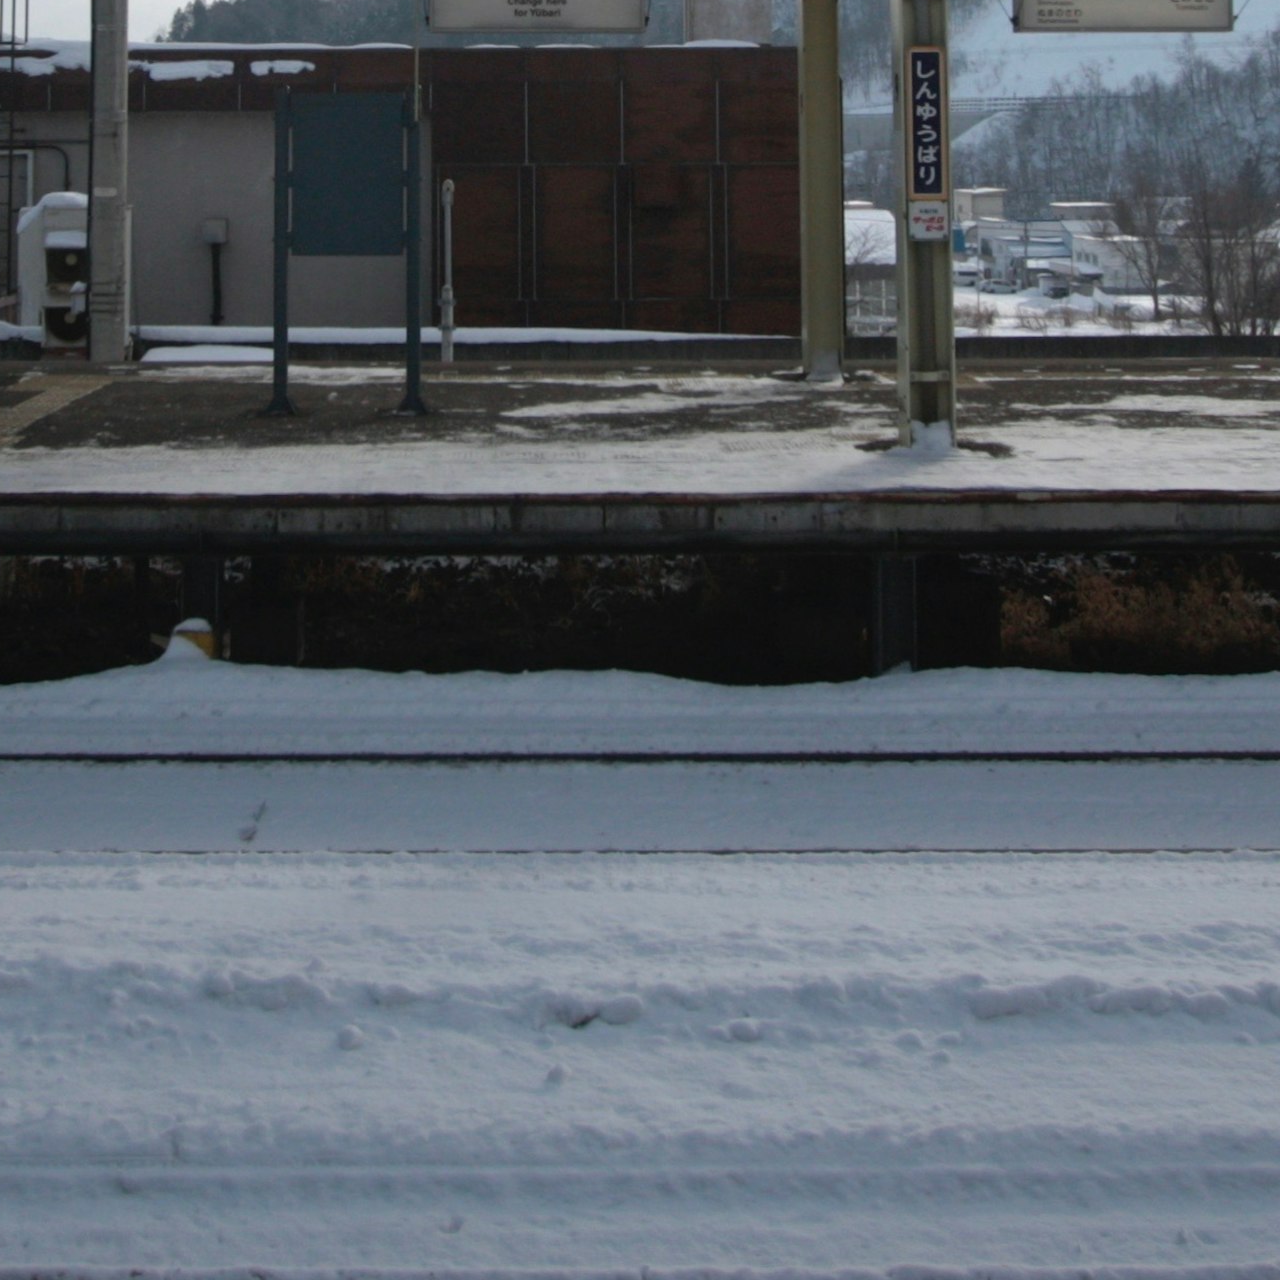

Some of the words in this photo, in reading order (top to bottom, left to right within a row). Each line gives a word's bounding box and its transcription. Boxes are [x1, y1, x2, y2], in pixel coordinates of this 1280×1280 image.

[514, 8, 528, 17] for
[915, 60, 940, 186] しんゆうばり
